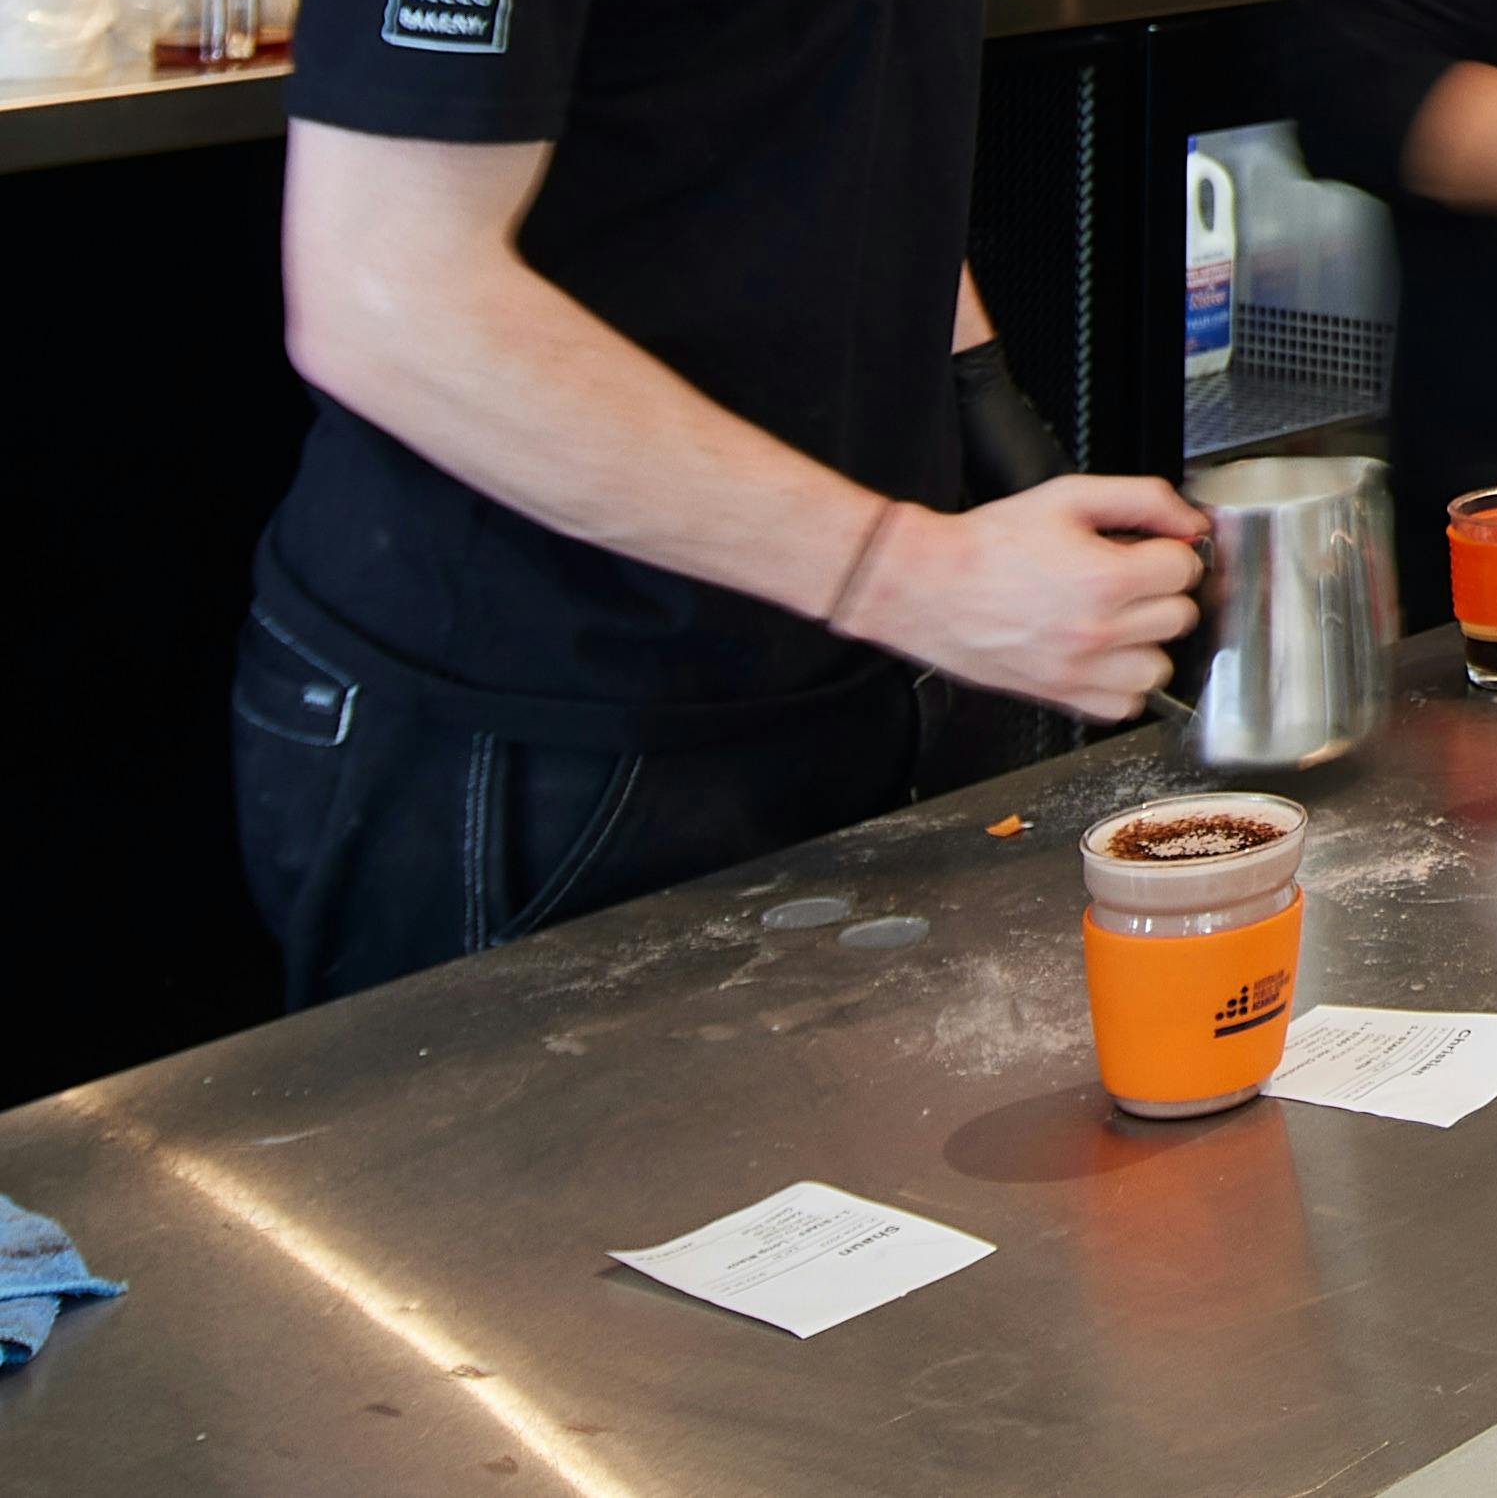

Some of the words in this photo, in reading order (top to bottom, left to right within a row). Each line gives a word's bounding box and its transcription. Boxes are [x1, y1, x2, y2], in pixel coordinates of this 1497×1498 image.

[399, 5, 489, 36] BAKERY
[1410, 1029, 1472, 1076] Christian
[837, 1225, 900, 1256] Shaun
